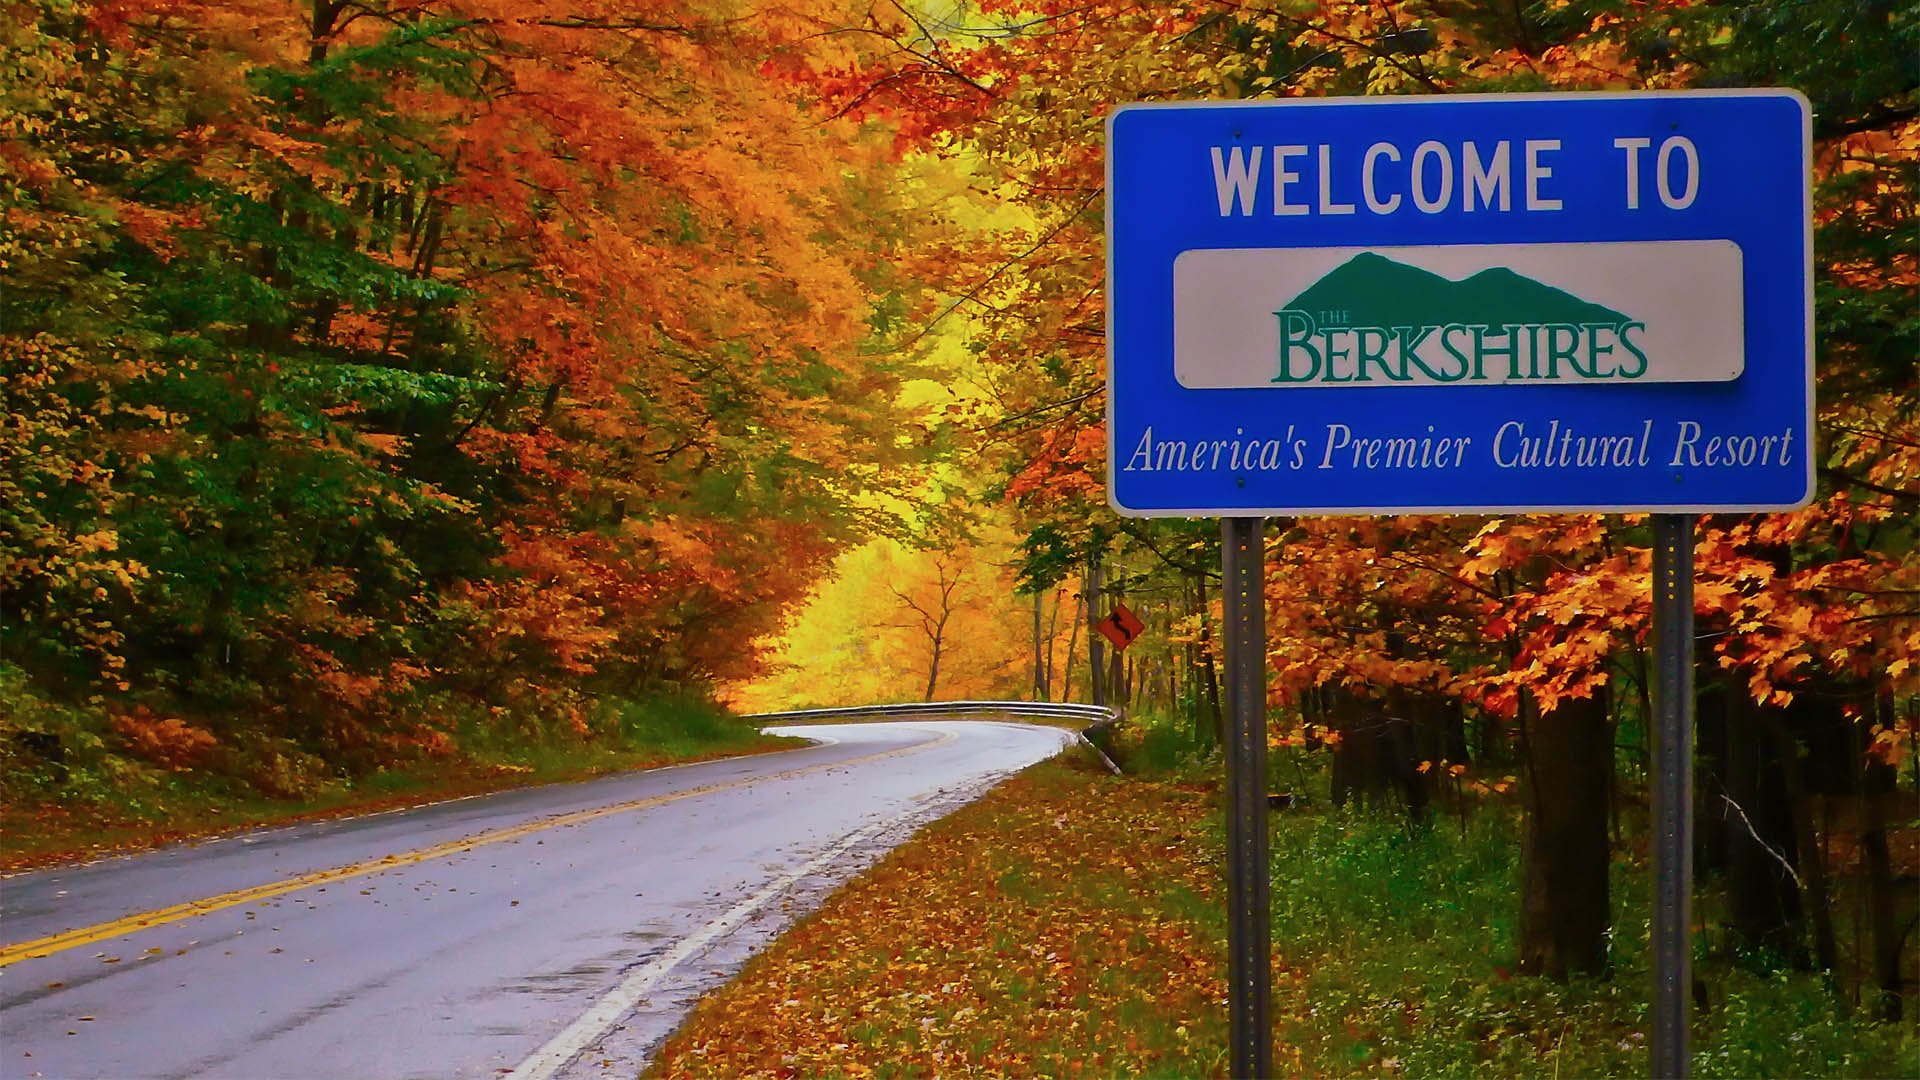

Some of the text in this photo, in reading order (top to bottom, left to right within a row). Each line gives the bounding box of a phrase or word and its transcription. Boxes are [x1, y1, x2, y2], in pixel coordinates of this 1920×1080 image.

[1210, 135, 1700, 217] WELCOME TO
[1270, 309, 1648, 382] BERKSHIRES
[1319, 310, 1351, 324] THE
[1123, 419, 1794, 473] America's Premier Cultural Resort
